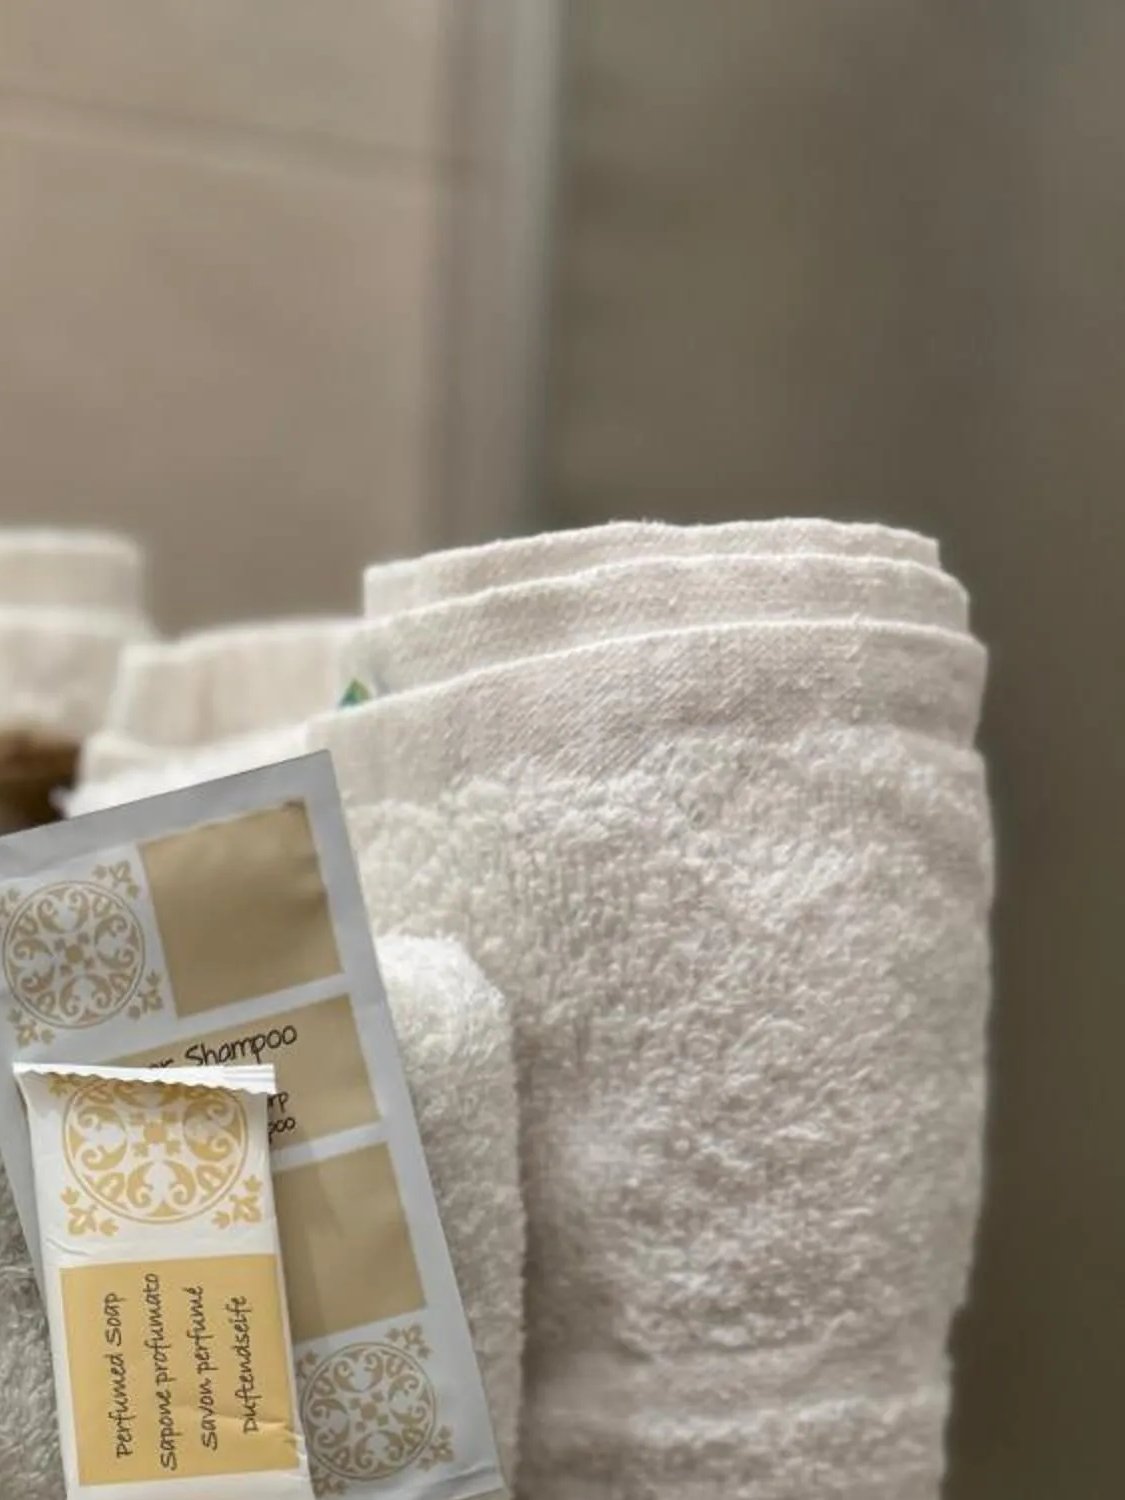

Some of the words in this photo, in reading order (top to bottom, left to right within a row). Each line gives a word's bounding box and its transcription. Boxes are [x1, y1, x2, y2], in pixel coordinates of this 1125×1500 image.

[185, 1025, 297, 1066] Shampoo
[267, 1092, 289, 1113] rp
[104, 1293, 126, 1346] Soap
[143, 1273, 176, 1387] profumato
[181, 1285, 219, 1375] perfumé
[225, 1296, 262, 1433] Duftendseife
[104, 1354, 135, 1458] Perfumed
[156, 1390, 183, 1470] Sapone
[197, 1378, 218, 1451] Savon
